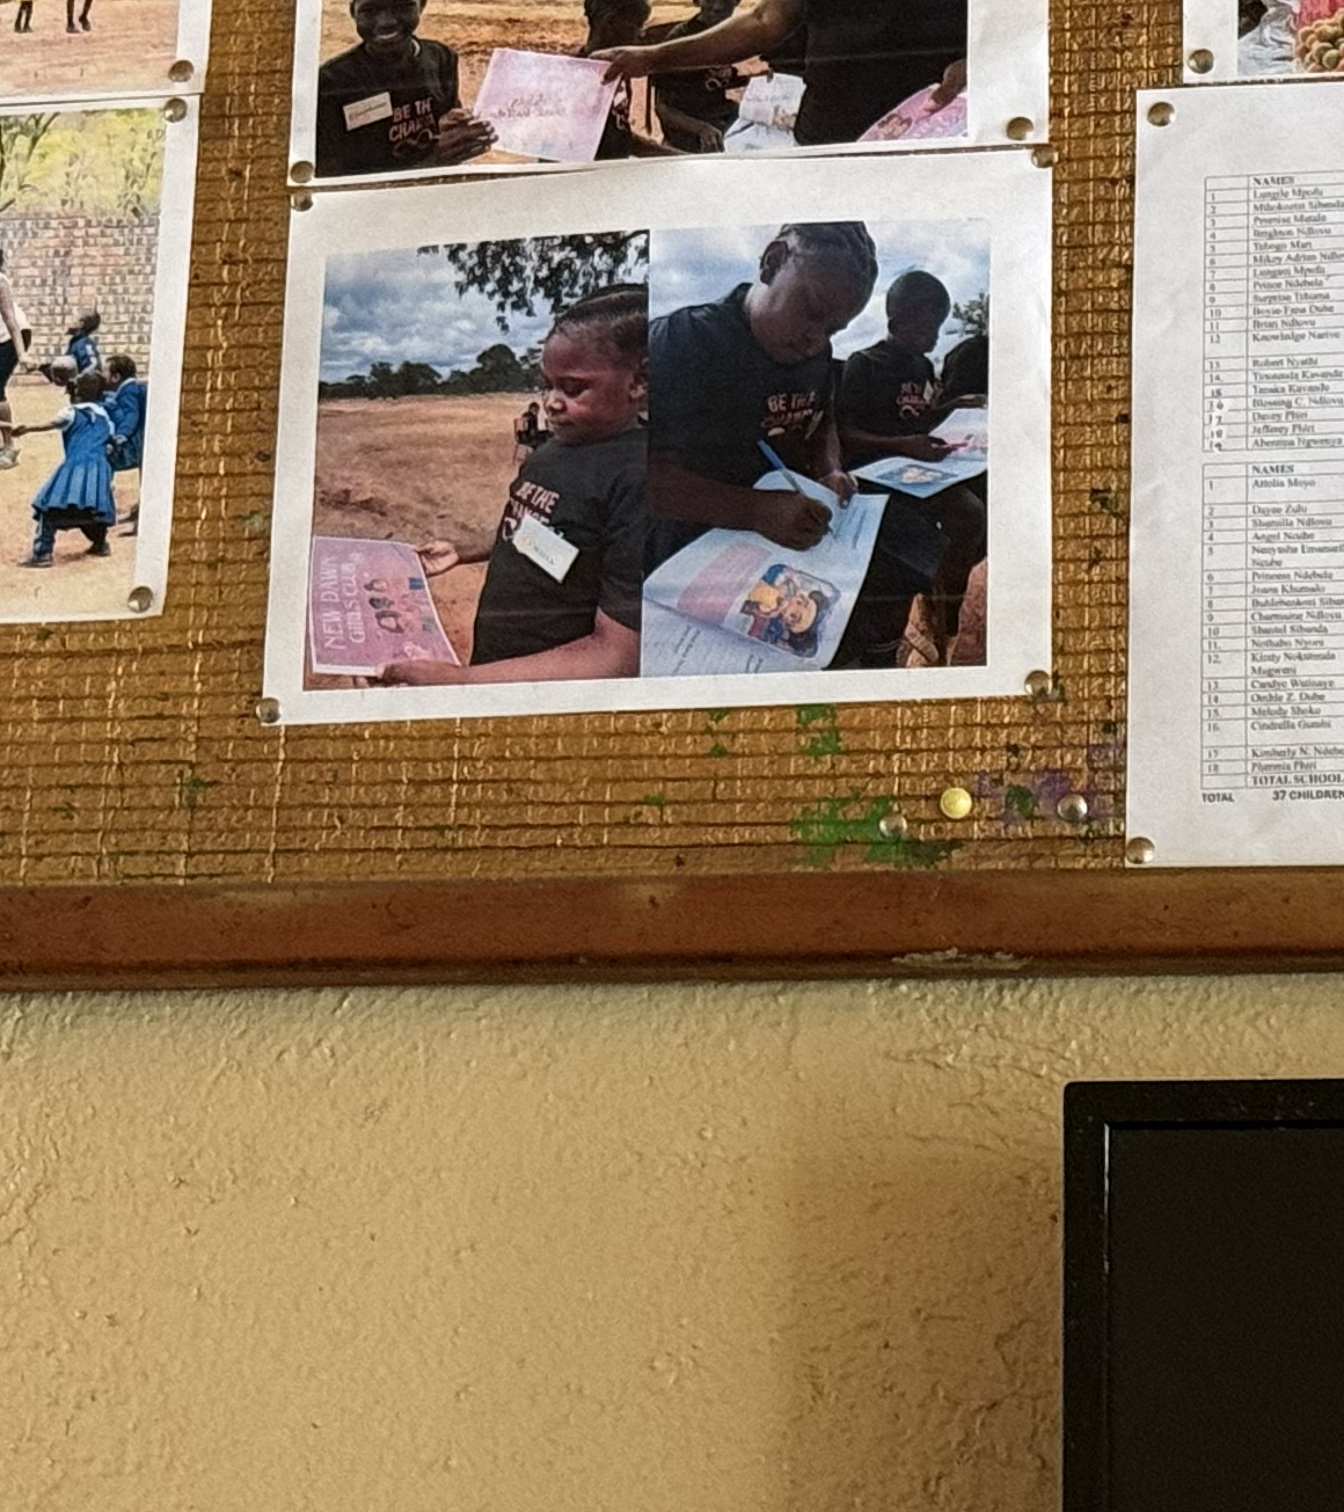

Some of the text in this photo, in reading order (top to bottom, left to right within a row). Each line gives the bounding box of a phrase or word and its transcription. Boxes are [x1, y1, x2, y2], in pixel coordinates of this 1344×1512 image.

[1253, 176, 1295, 186] NAMES
[1252, 464, 1294, 475] NAMES
[1252, 774, 1291, 786] TOTAL
[1293, 773, 1344, 785] SCHOOL
[1202, 793, 1235, 803] TOTAL
[1272, 790, 1287, 801] 37
